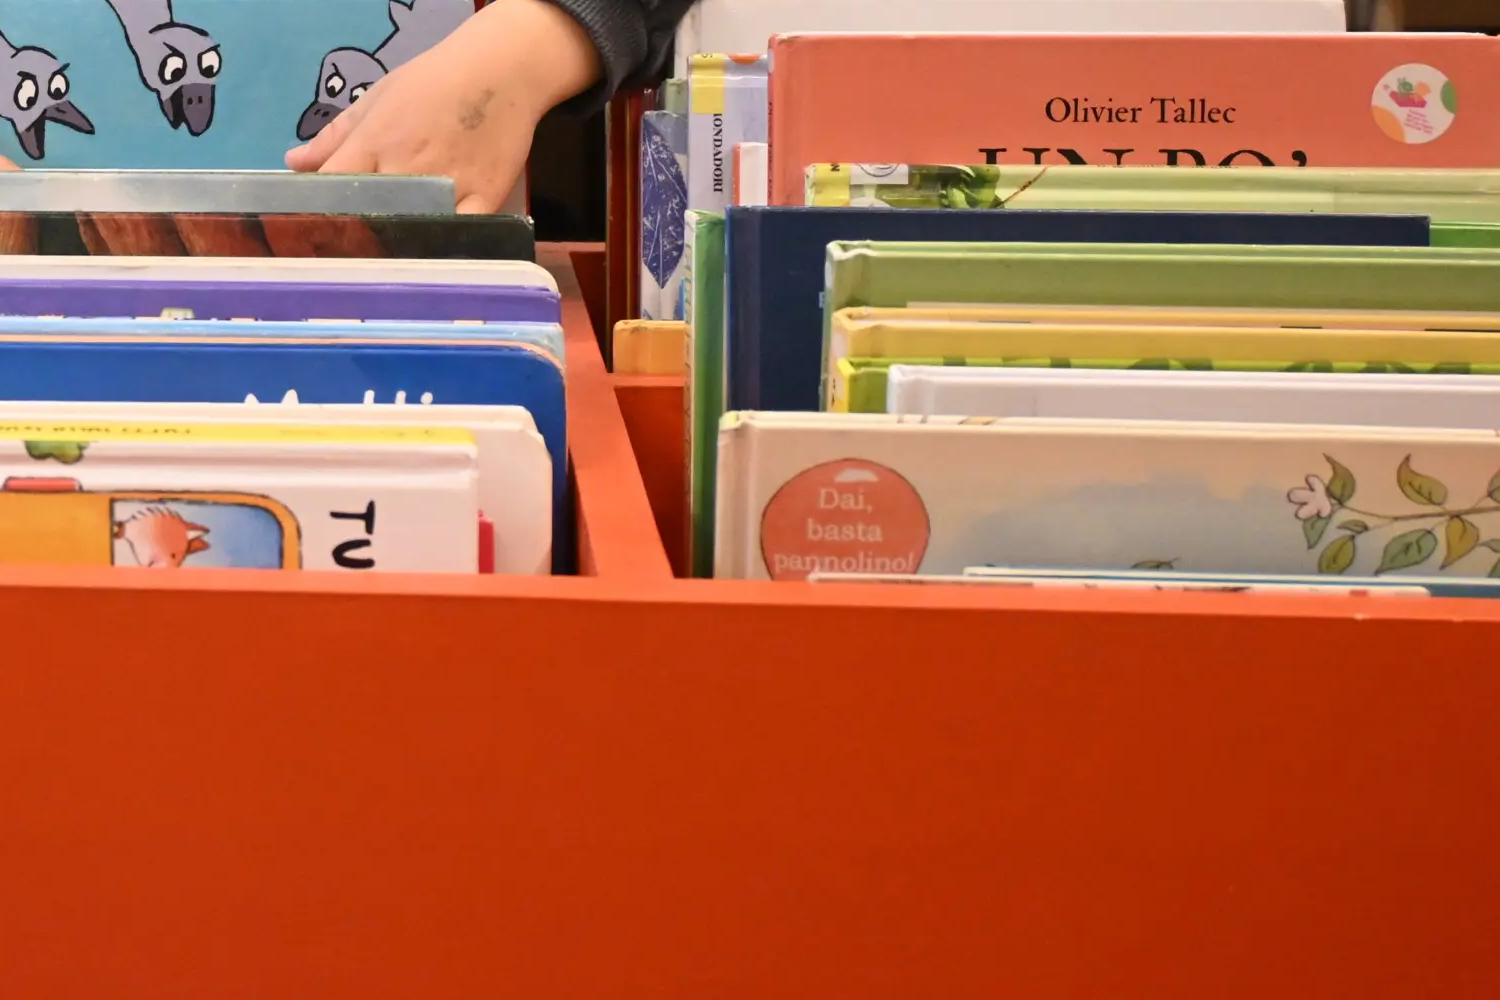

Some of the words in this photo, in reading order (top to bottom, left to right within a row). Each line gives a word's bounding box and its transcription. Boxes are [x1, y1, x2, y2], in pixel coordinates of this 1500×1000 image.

[1045, 96, 1142, 124] Olivier
[1149, 96, 1237, 124] Tallec
[818, 487, 873, 513] Dai,
[329, 500, 376, 569] TU
[807, 518, 883, 542] basta
